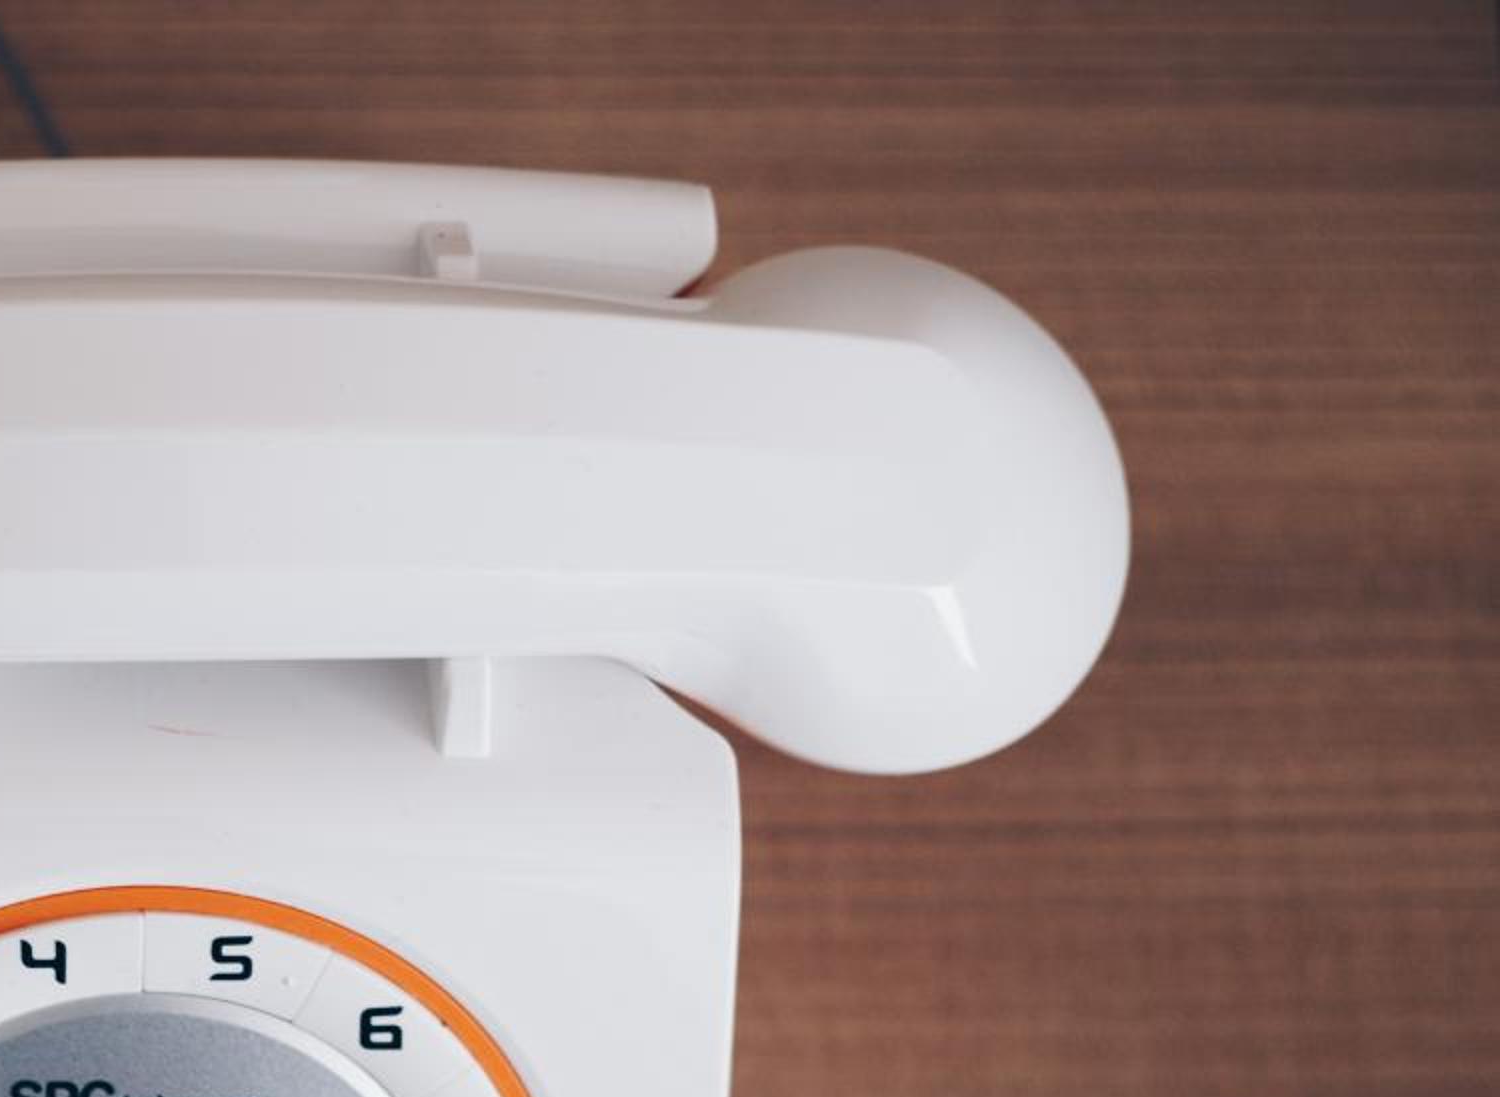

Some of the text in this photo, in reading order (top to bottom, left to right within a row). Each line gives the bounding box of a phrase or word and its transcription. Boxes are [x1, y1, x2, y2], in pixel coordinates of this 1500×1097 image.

[19, 939, 67, 985] 4
[209, 935, 254, 981] 5
[359, 1005, 404, 1051] 6
